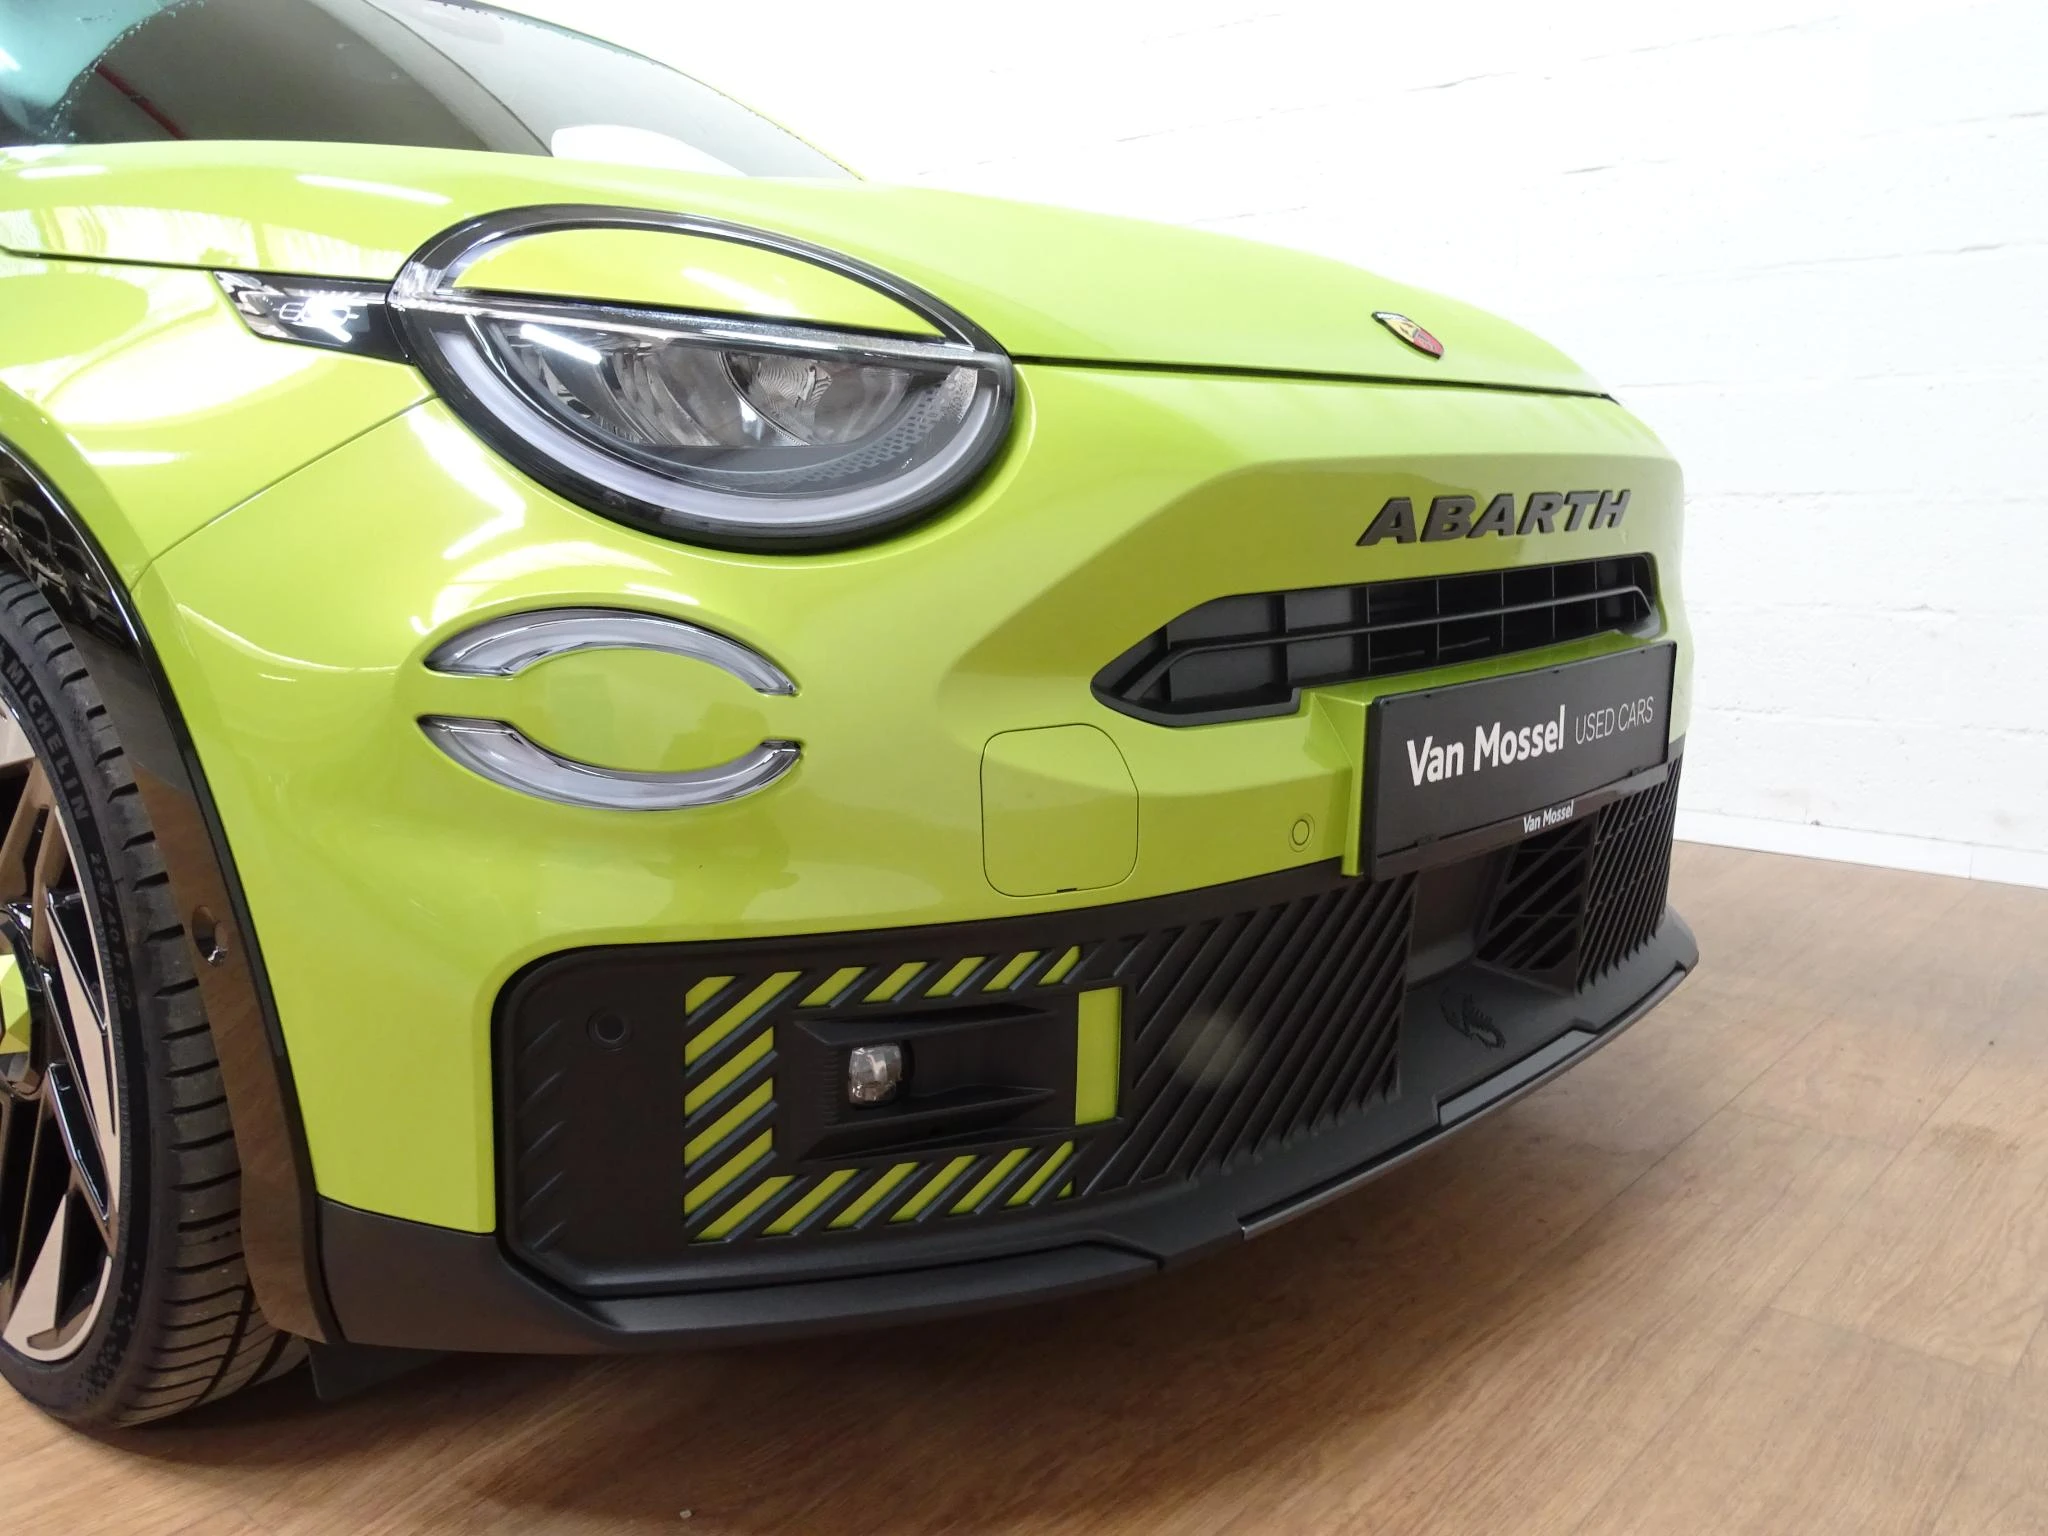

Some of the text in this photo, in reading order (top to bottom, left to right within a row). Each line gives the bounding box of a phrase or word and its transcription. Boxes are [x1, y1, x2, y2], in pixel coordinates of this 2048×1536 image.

[1356, 489, 1631, 546] ABARTH
[6, 658, 90, 821] MICHELIN
[1406, 695, 1654, 787] Van Mossel USED CARS
[1523, 799, 1575, 834] Van Mossel
